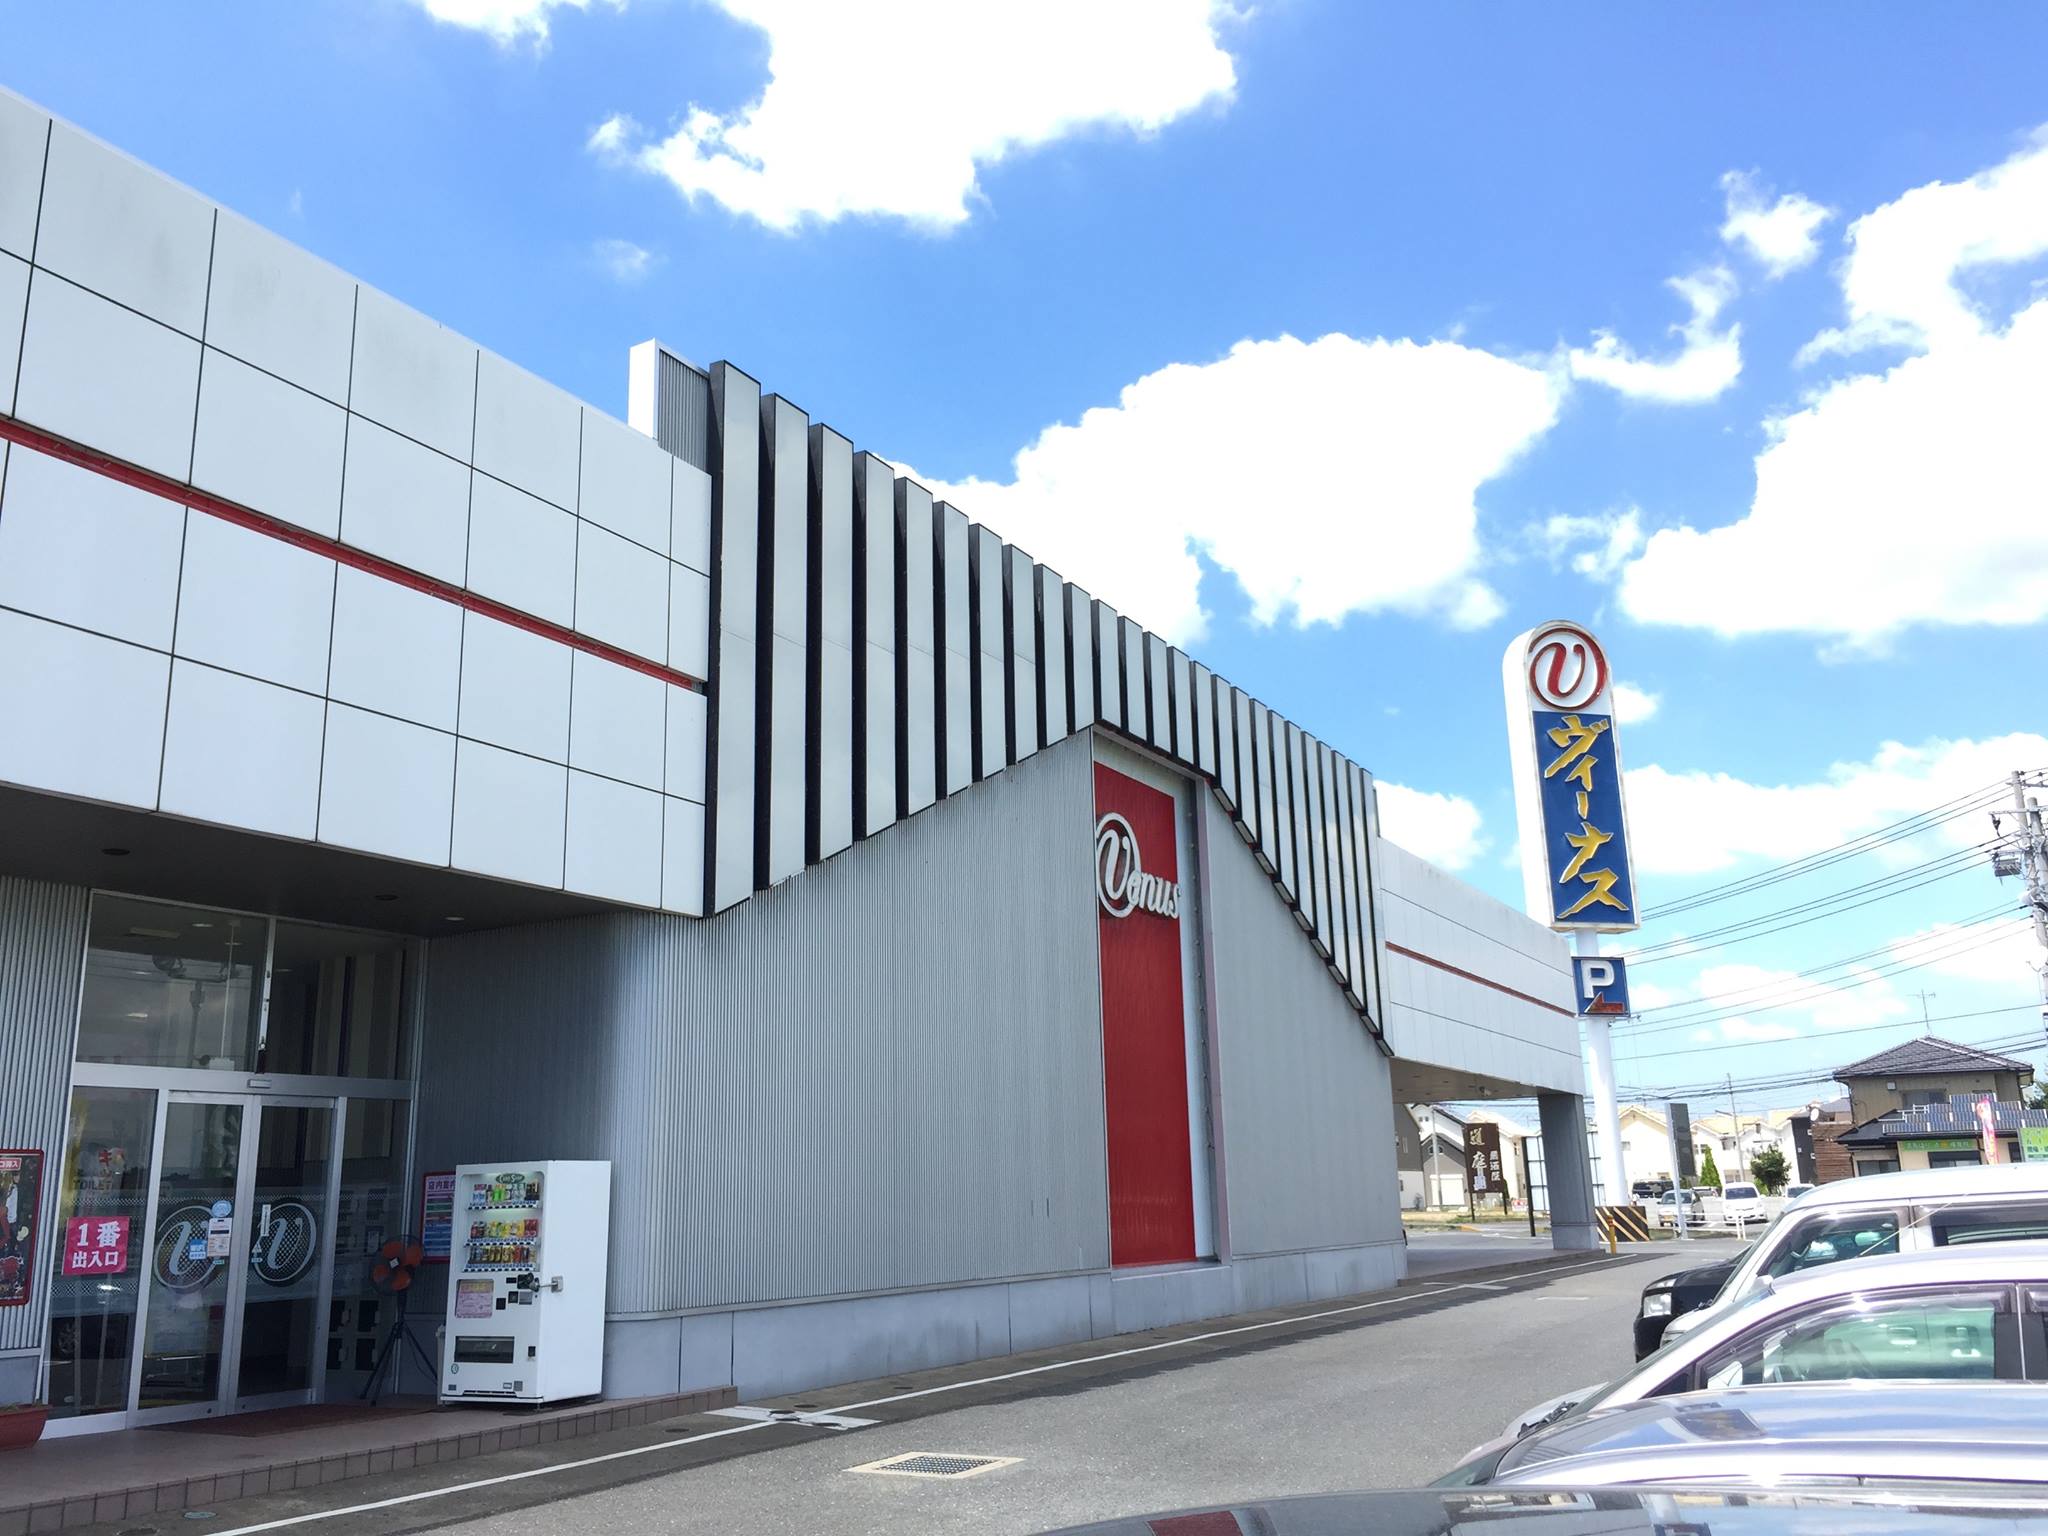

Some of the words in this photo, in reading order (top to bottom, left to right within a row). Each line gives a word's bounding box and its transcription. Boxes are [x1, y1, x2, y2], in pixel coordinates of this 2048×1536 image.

[1544, 715, 1630, 919] ヴィーナス
[1095, 811, 1181, 919] Venus
[1581, 960, 1614, 998] P
[77, 1221, 120, 1248] 1番
[72, 1251, 119, 1269] 出入口
